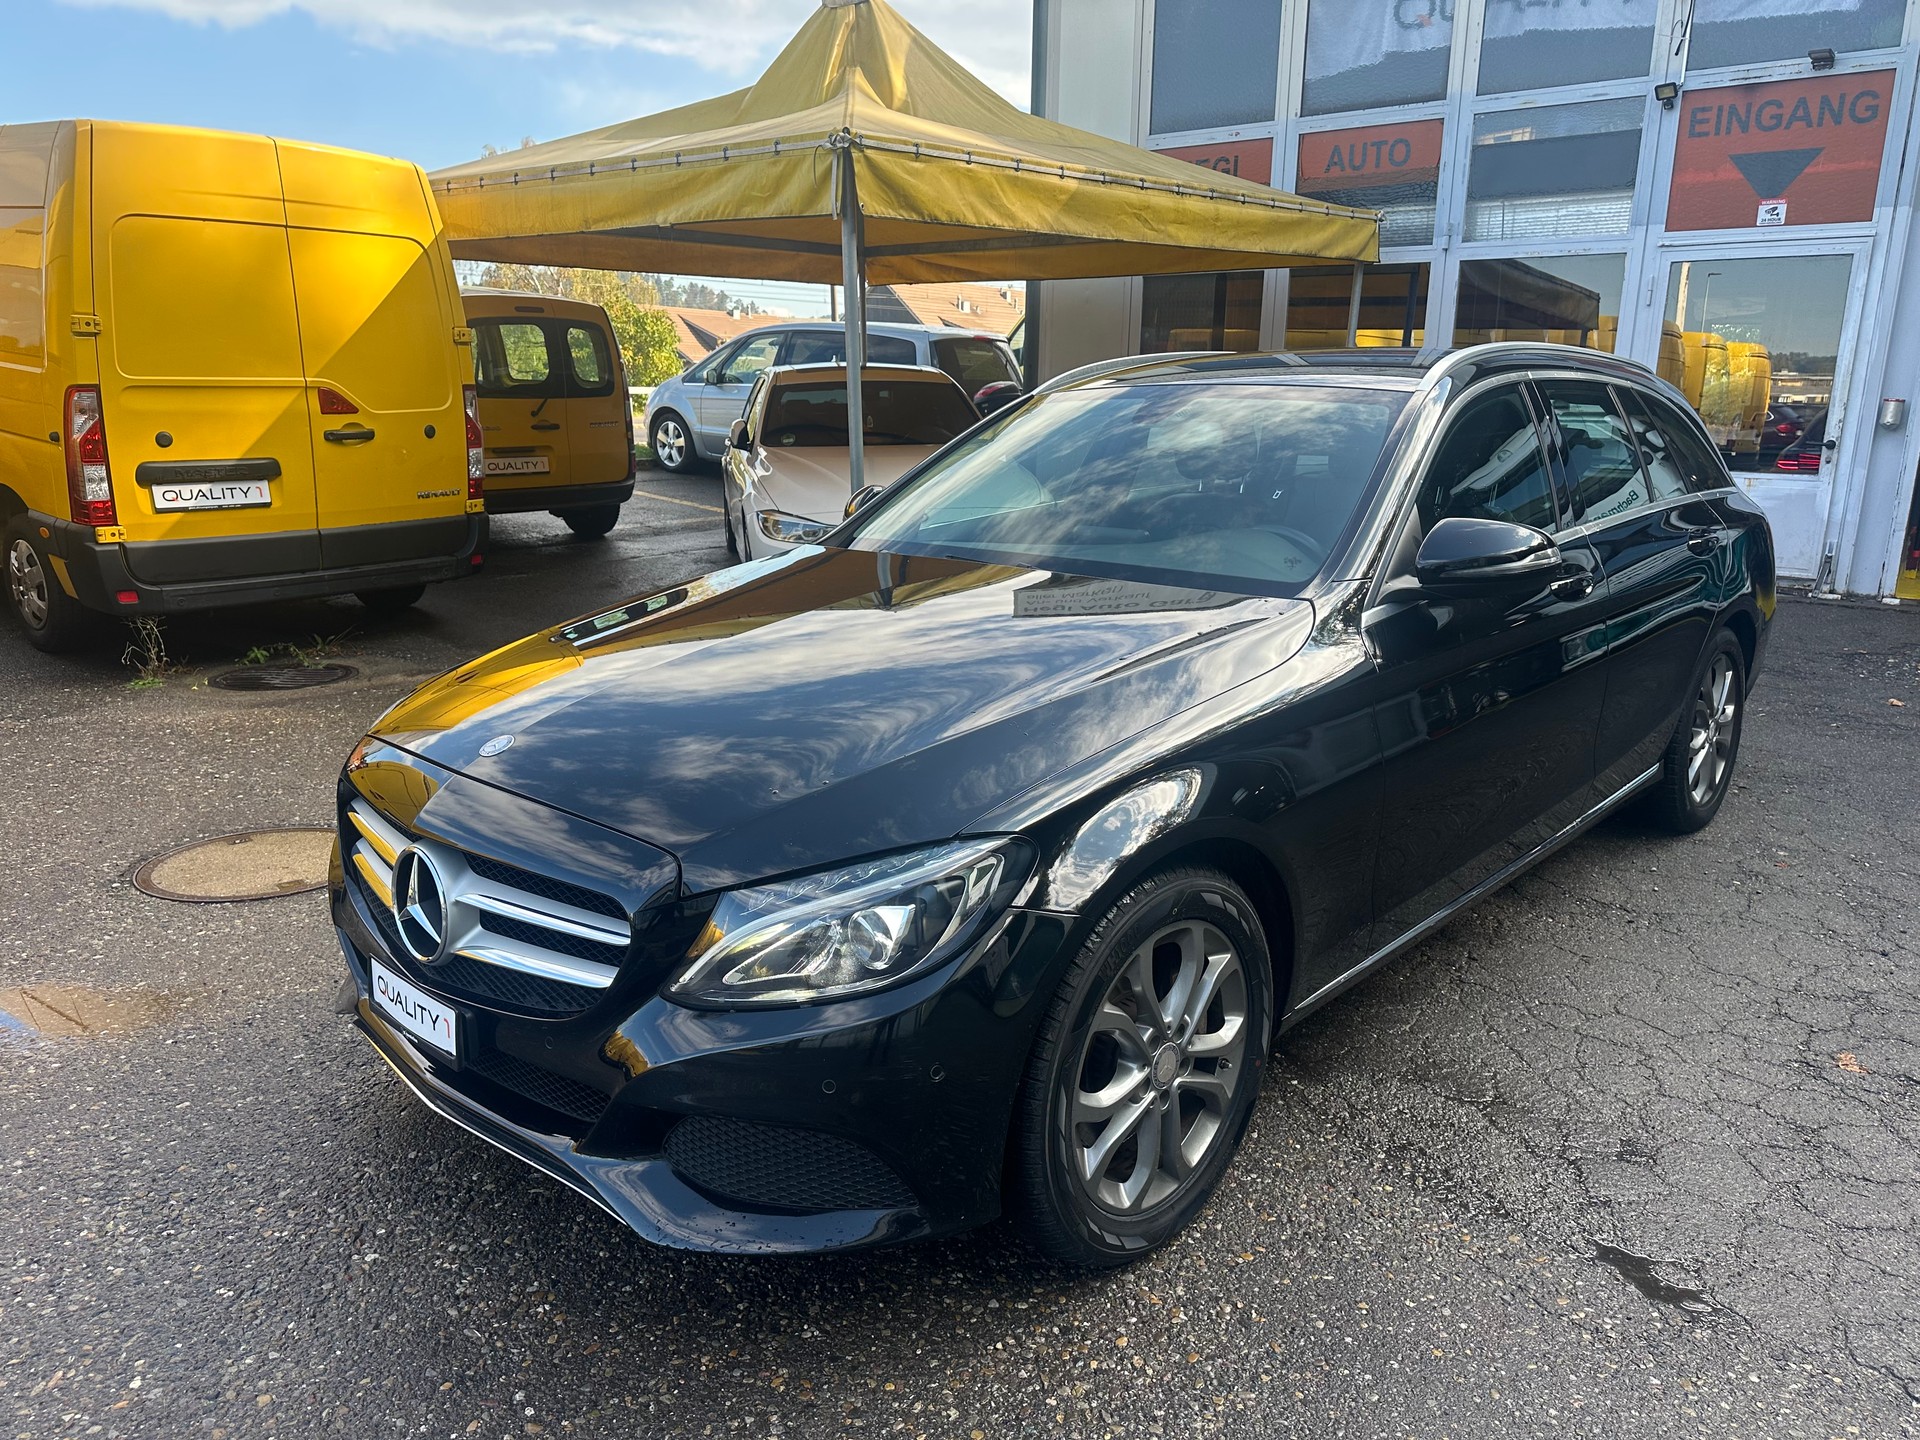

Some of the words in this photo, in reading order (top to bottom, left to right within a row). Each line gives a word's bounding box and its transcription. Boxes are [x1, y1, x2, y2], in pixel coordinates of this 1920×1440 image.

[1687, 89, 1881, 139] EINGANG
[1323, 137, 1411, 173] AUTO
[487, 460, 538, 471] QUALITY
[162, 486, 251, 502] QUALITY
[255, 486, 263, 498] 1
[417, 488, 461, 499] RENAULT
[377, 974, 440, 1031] QUALITY
[443, 1017, 451, 1039] 1
